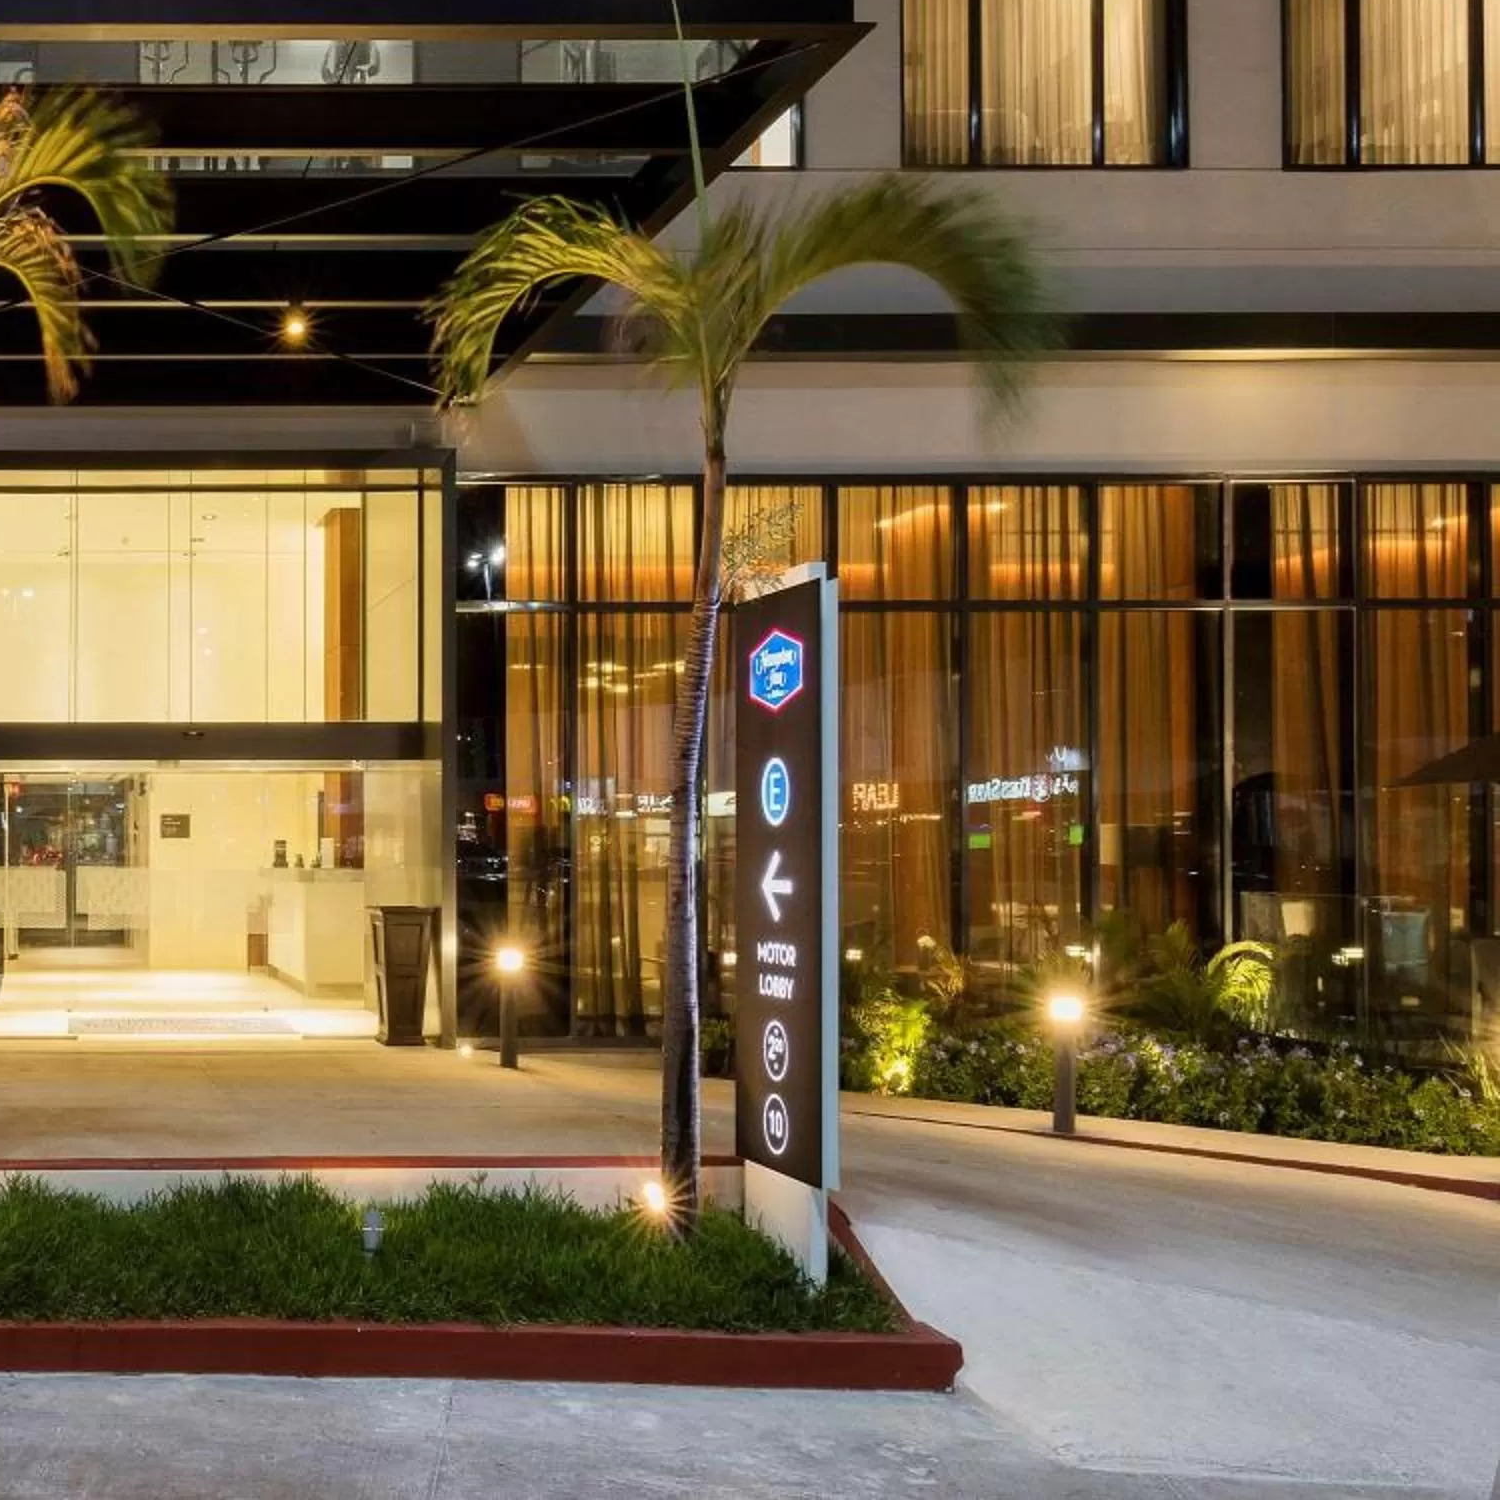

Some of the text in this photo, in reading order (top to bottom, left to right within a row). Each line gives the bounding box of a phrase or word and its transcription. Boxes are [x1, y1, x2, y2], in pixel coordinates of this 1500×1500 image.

[757, 941, 797, 967] MOTOR
[759, 973, 795, 1000] LOBBY
[768, 1109, 783, 1138] 10
